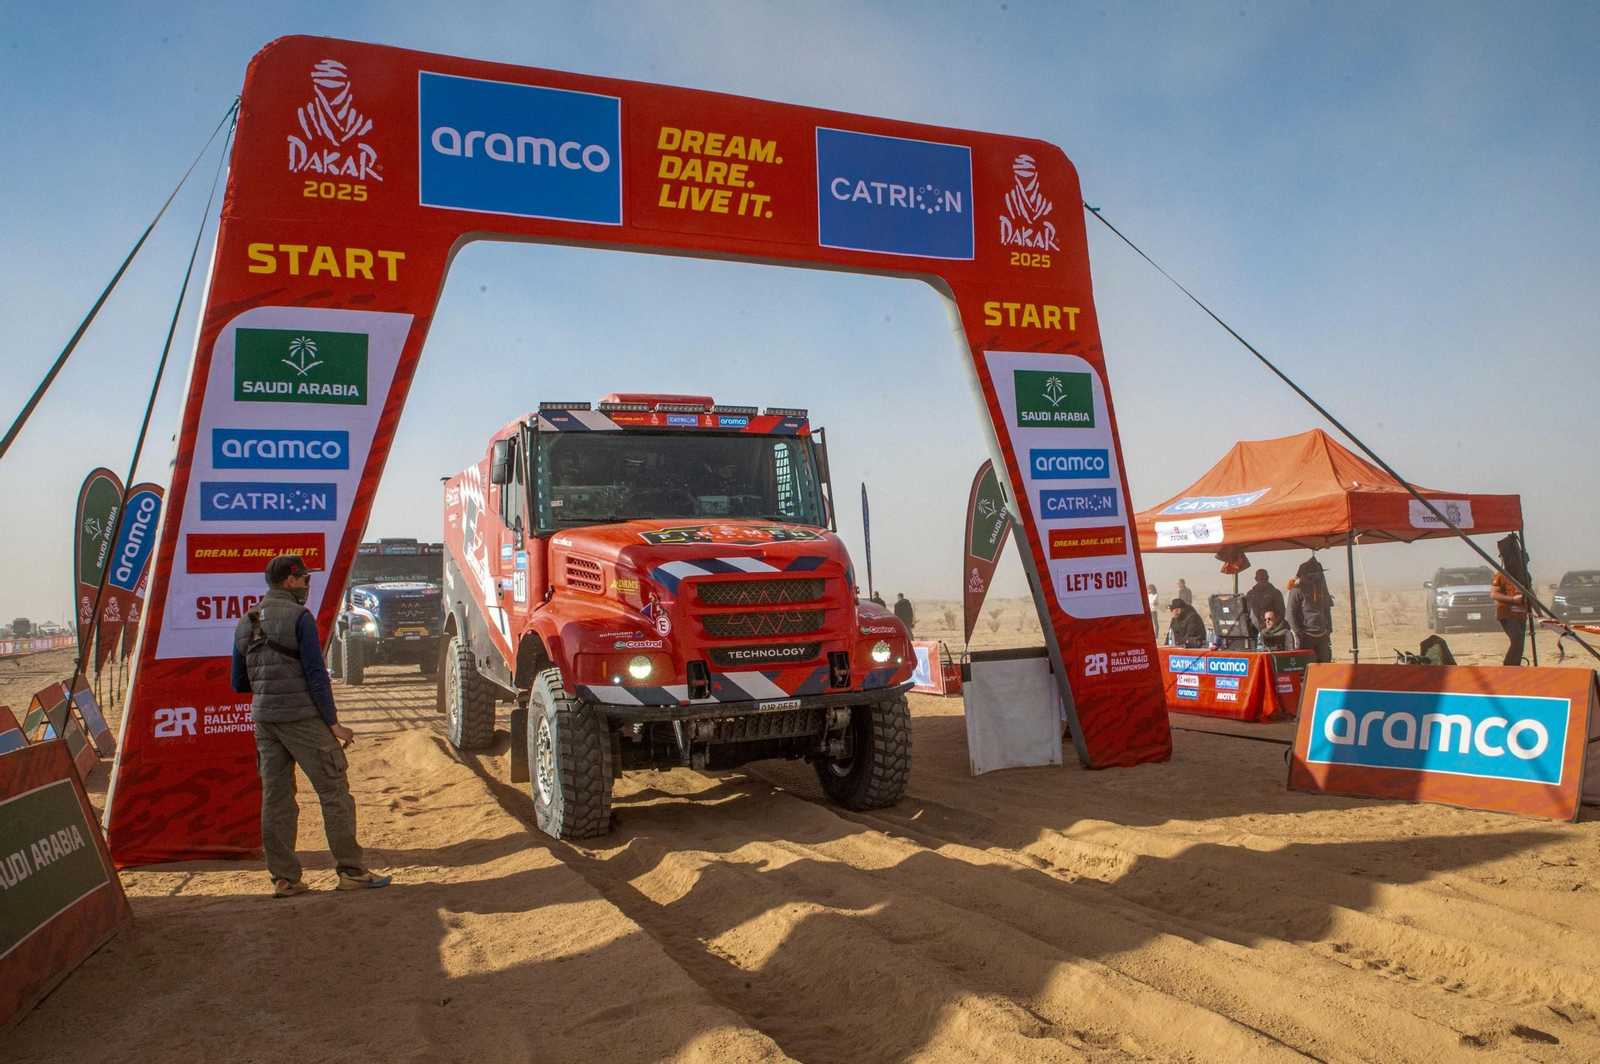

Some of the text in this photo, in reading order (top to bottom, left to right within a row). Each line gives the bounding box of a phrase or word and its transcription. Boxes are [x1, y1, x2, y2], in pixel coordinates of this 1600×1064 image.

[431, 126, 610, 173] aramco
[657, 126, 783, 164] DREAM.
[287, 135, 383, 181] DAKAR
[657, 154, 755, 188] DARE.
[303, 181, 368, 202] 2025
[658, 183, 773, 219] LIVE IT.
[831, 177, 962, 214] CATRION
[999, 215, 1060, 252] DAKAR
[248, 242, 406, 282] START
[1010, 251, 1051, 268] 2025
[984, 301, 1080, 331] START
[242, 381, 360, 397] SAUDI ARABIA
[720, 417, 747, 425] aramco
[1021, 411, 1090, 422] SAUDI ARABIA
[222, 439, 341, 459] aramco
[1035, 456, 1105, 471] aramco
[212, 490, 327, 512] CATRION
[1047, 494, 1112, 511] CATRION
[96, 506, 118, 568] SAUDI ARABIA
[116, 497, 156, 582] aramco
[989, 519, 1003, 545] SAUDI
[1080, 538, 1099, 546] DARE.
[195, 547, 318, 558] DREAM. DARE. LIVE IT.
[1066, 570, 1128, 592] LET'S GO!
[196, 595, 265, 620] STAG
[659, 620, 667, 631] E
[626, 640, 663, 648] Castrol
[728, 647, 805, 659] TECHNOLOGY
[1085, 652, 1108, 676] 2R
[1111, 655, 1148, 666] RALLY-RAID
[1111, 663, 1150, 673] CHAMPIONSHIP
[1210, 661, 1246, 672] aramco
[1178, 689, 1197, 697] aramco
[1216, 692, 1237, 701] MOTUL
[154, 707, 197, 738] 2R
[204, 712, 255, 725] RALLY-R
[1324, 708, 1549, 760] aramco
[0, 824, 86, 890] AUDI ARABIA
